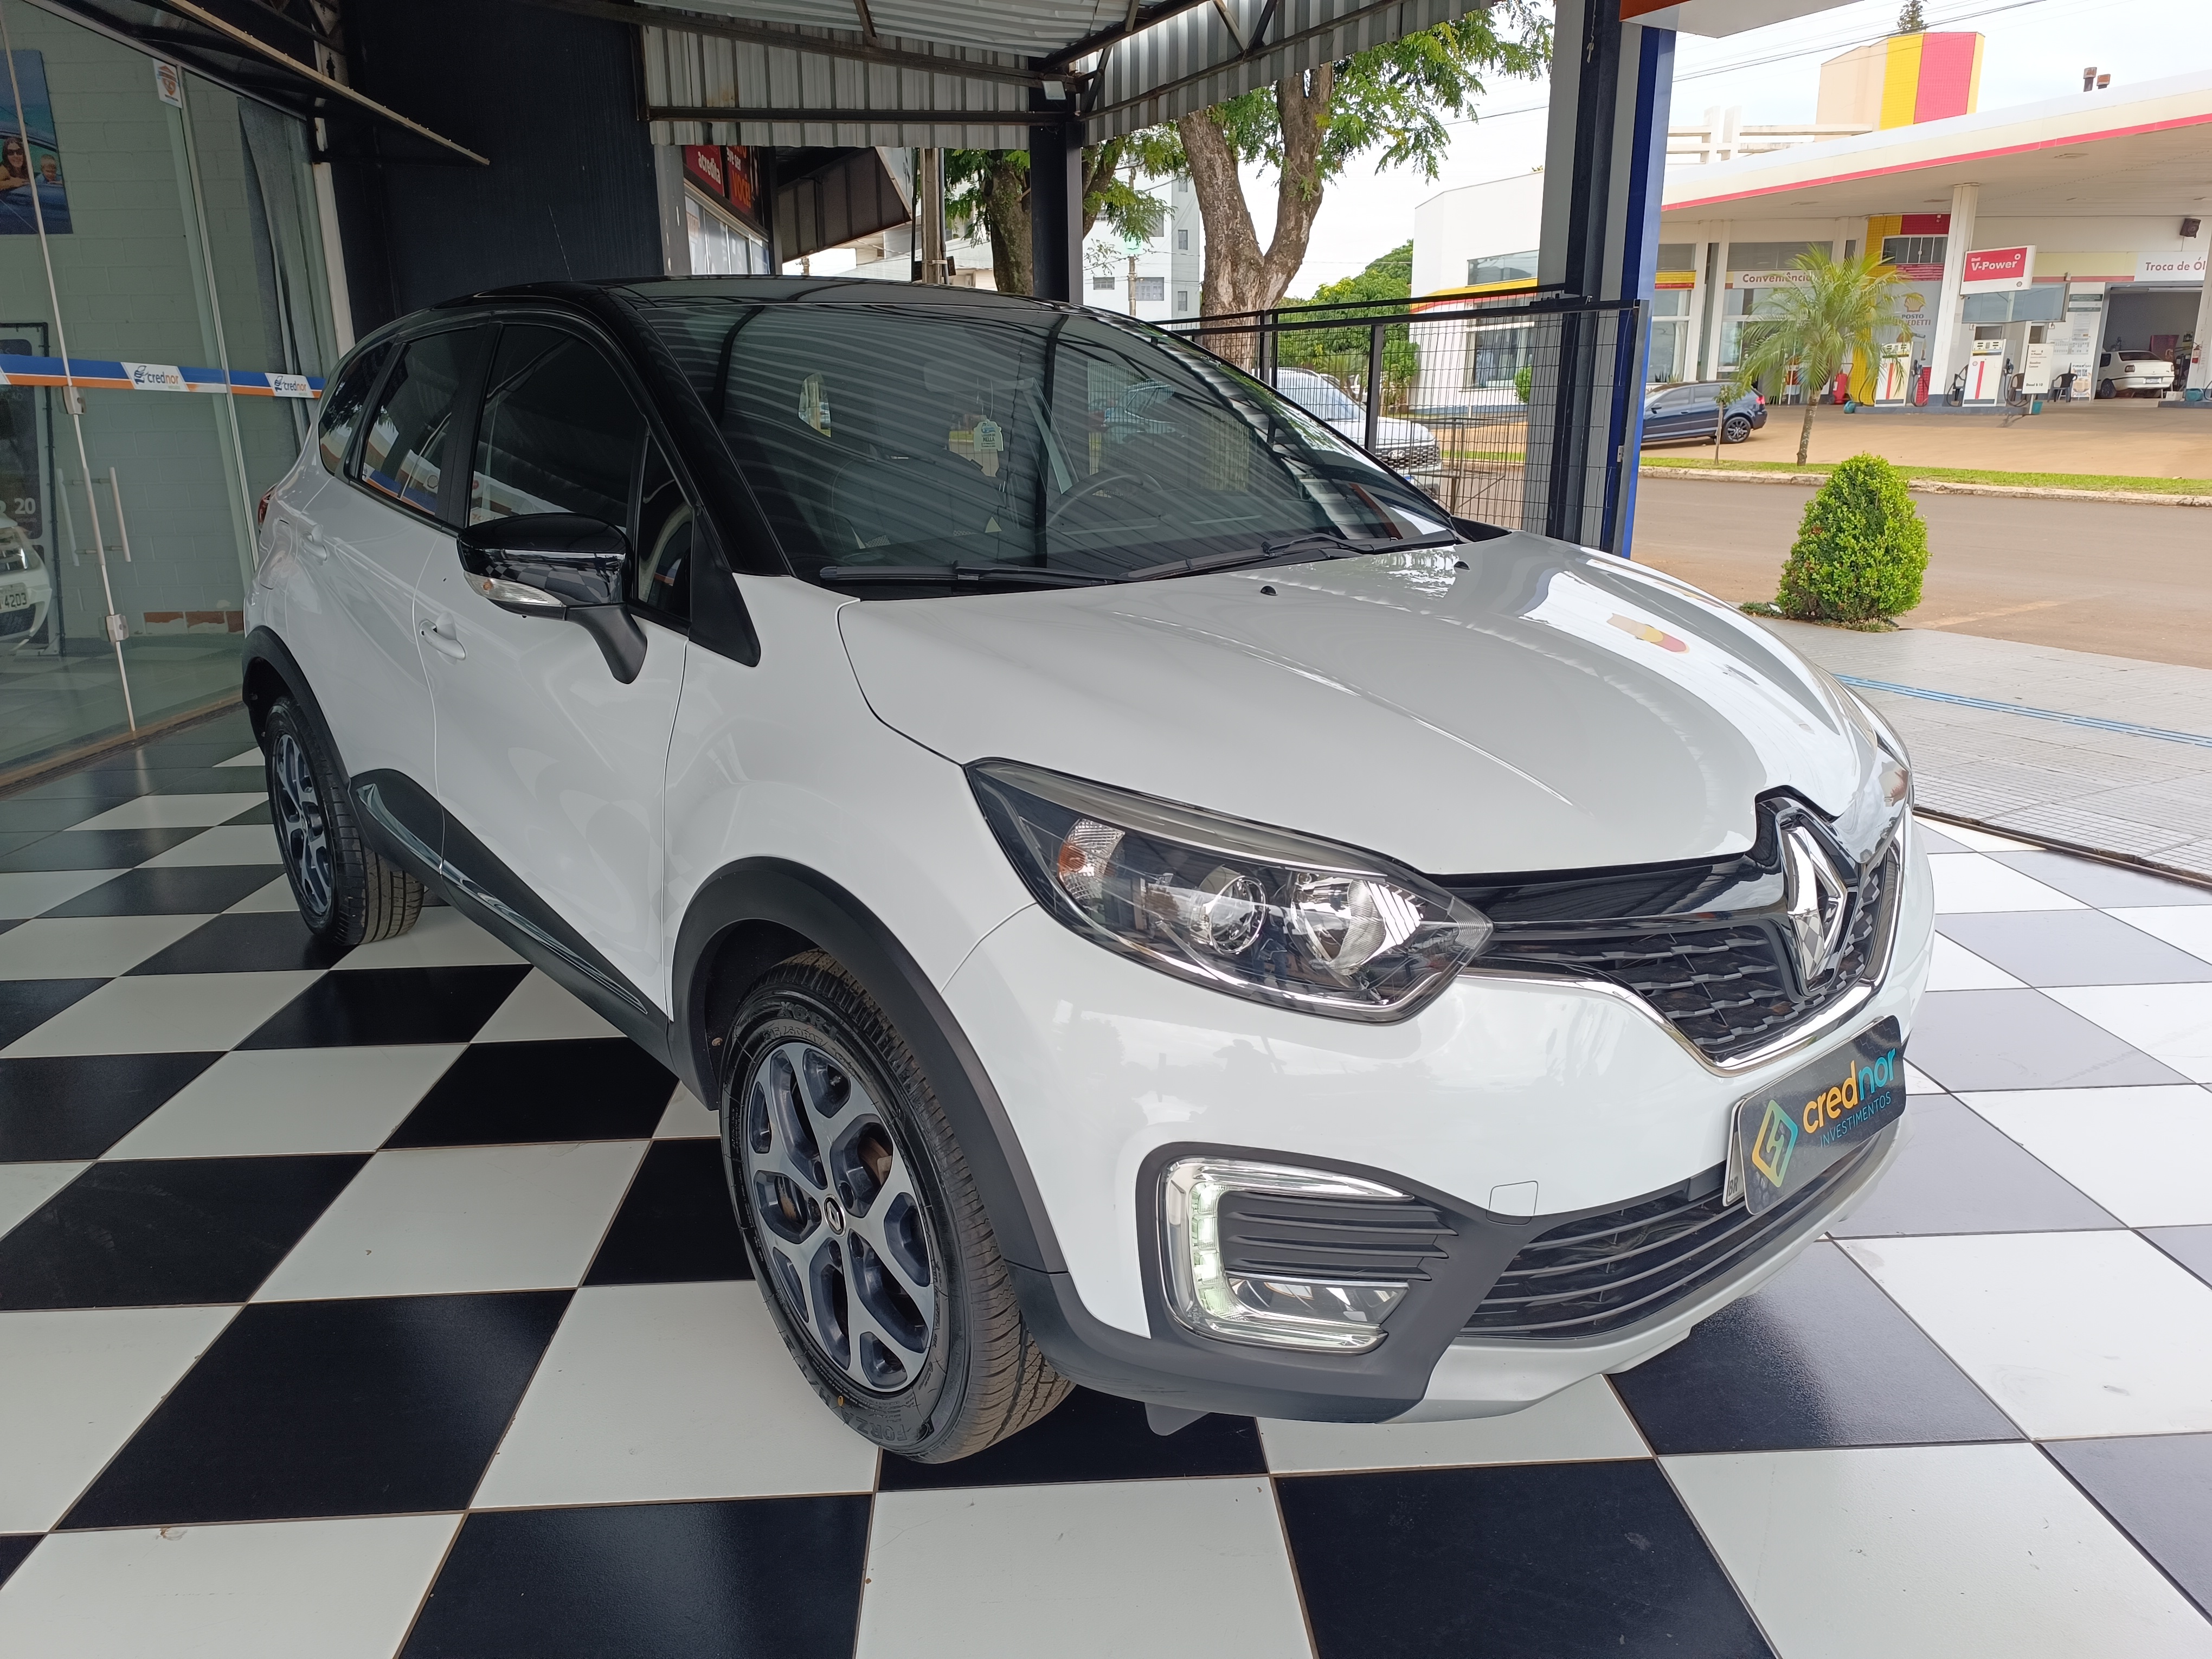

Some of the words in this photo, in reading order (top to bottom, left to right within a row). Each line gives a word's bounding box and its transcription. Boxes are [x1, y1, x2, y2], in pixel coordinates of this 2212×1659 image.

[1971, 260, 2018, 271] V-Power
[2145, 262, 2174, 271] Troca
[2177, 261, 2190, 271] de
[2194, 256, 2206, 271] Ól
[147, 371, 179, 384] crednor
[284, 381, 306, 391] crednor
[14, 497, 36, 515] 20
[1803, 1047, 1896, 1134] crednor
[1819, 1091, 1892, 1149] INVESTIMENTOS
[1728, 1175, 1739, 1197] BR
